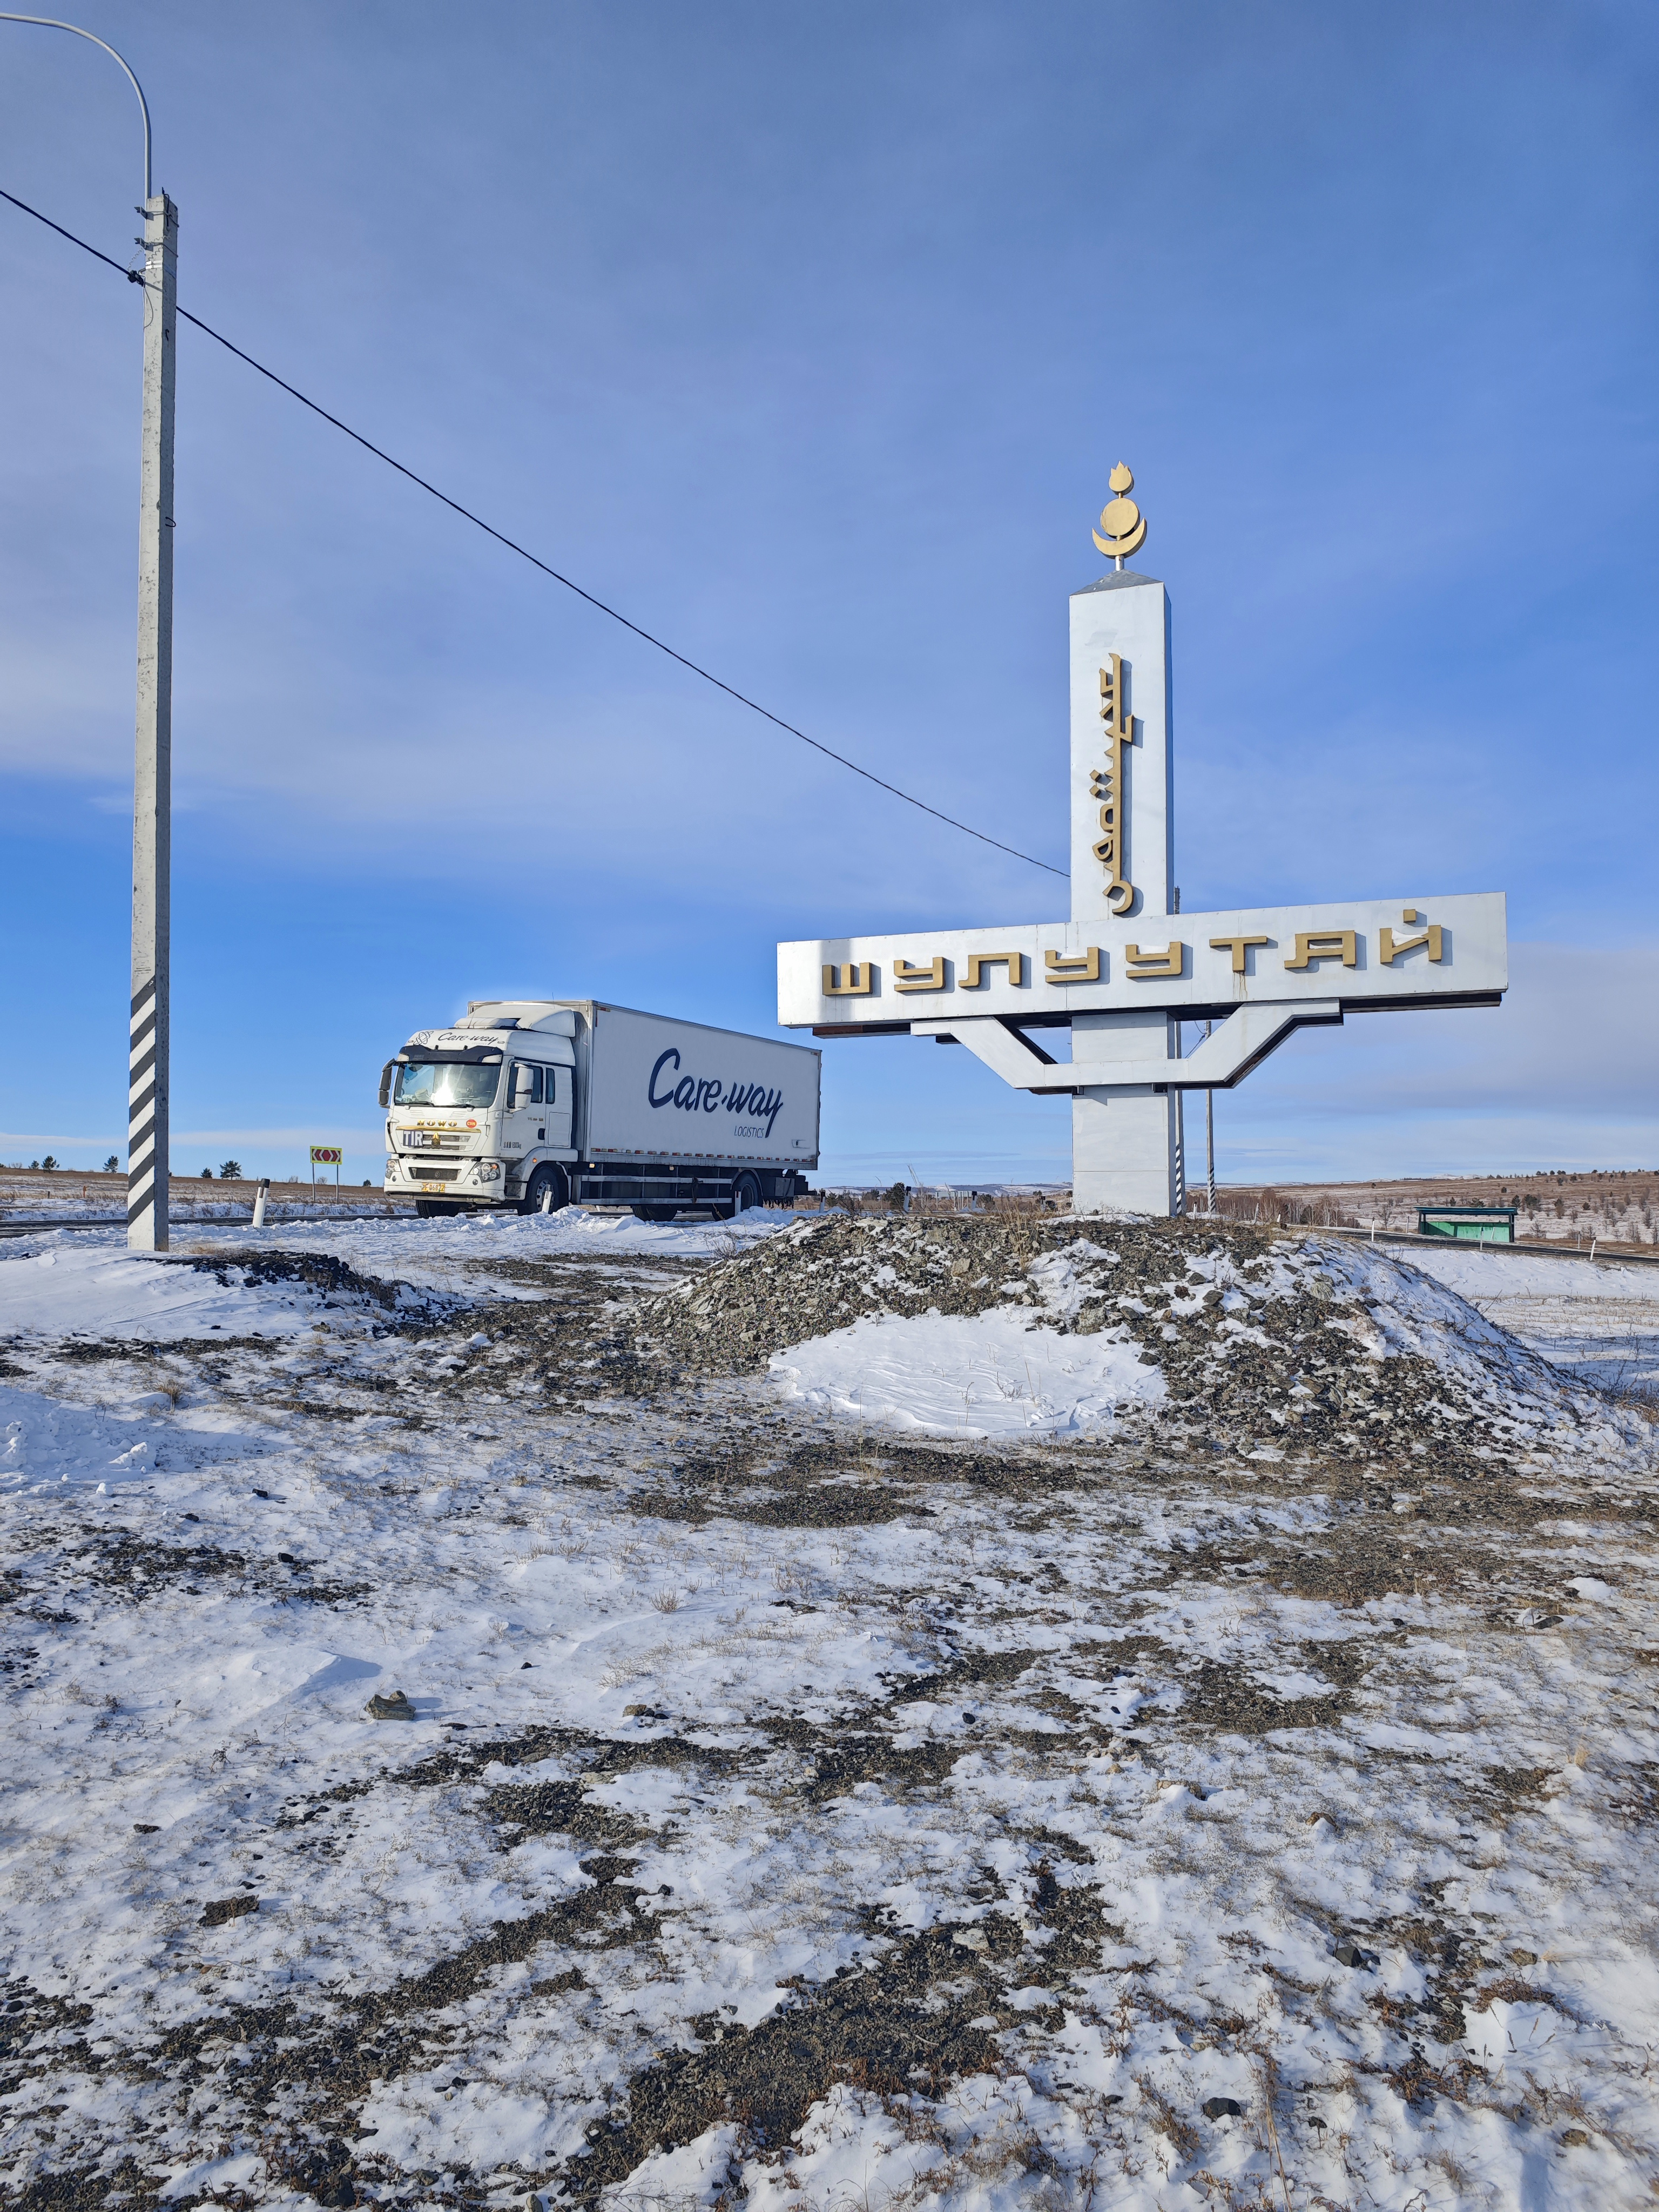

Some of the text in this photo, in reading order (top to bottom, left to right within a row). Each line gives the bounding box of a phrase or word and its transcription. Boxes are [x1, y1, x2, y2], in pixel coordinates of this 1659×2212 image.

[821, 909, 1443, 997] ШУЛУУТАЙ
[417, 1119, 457, 1127] HOWO
[403, 1130, 423, 1146] TIR
[734, 1125, 765, 1138] LOGISTICS
